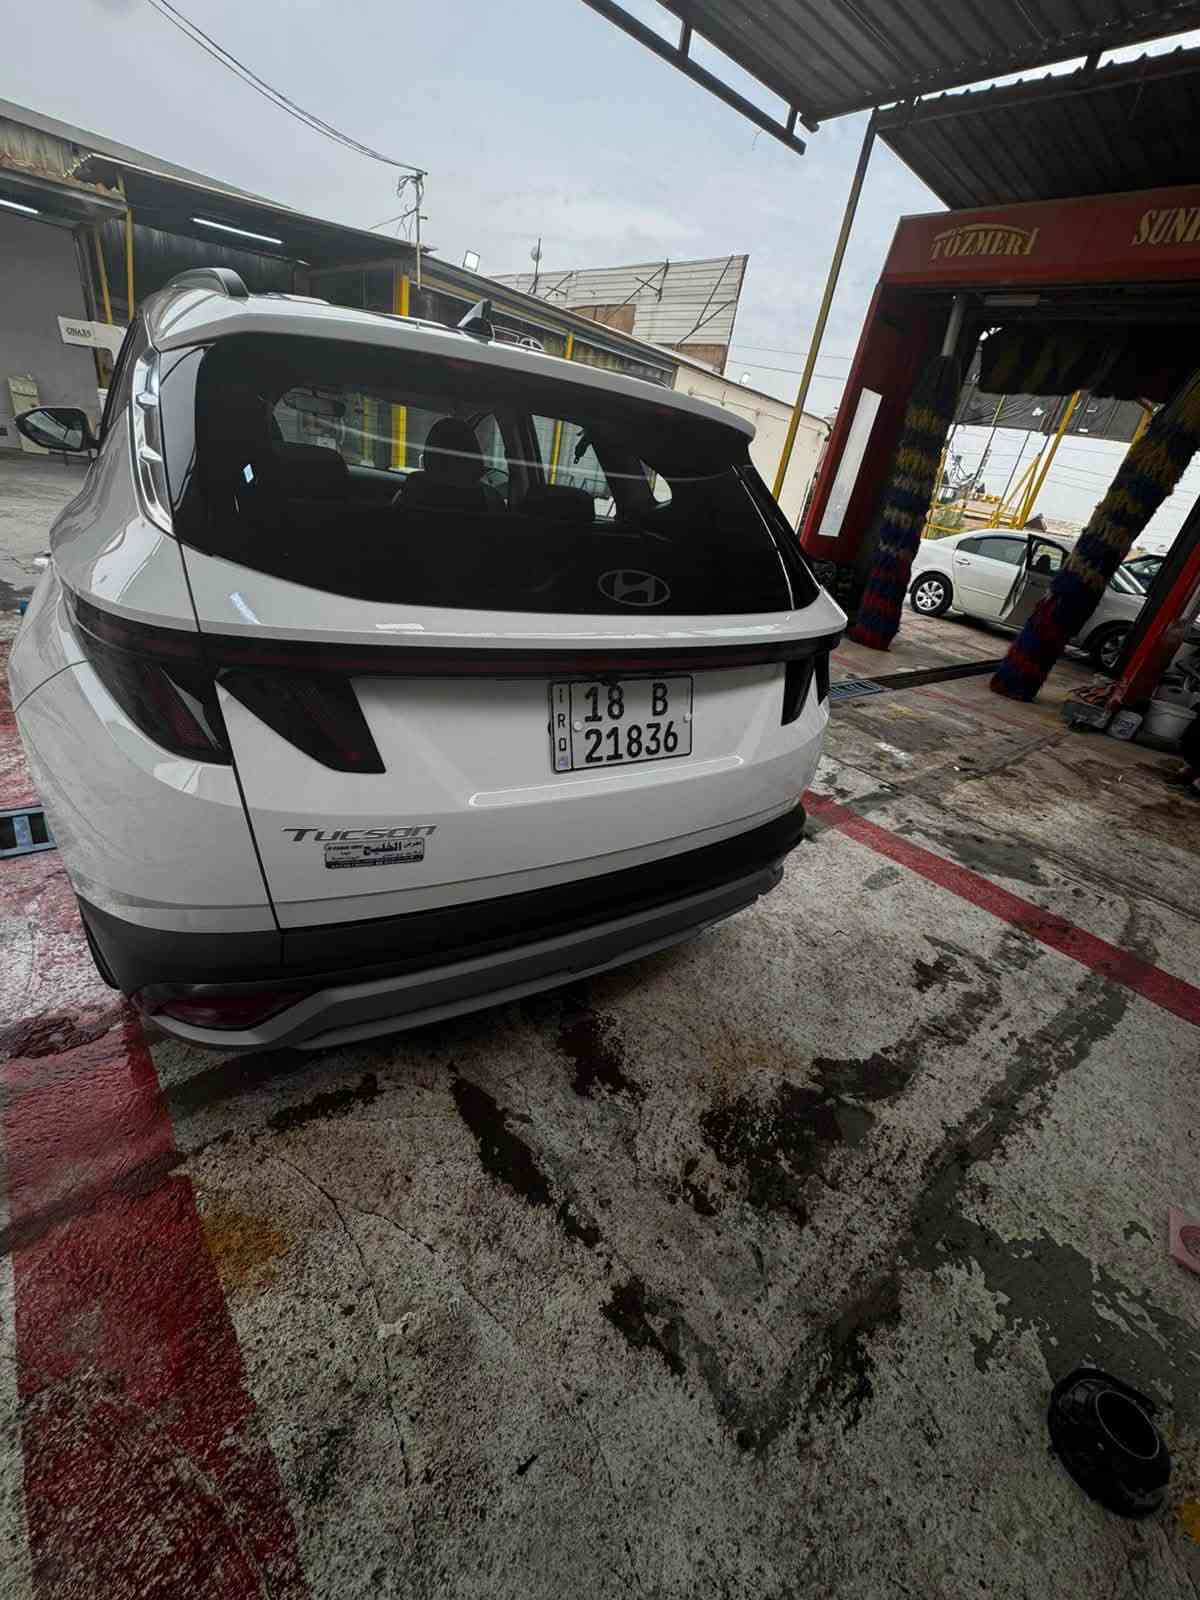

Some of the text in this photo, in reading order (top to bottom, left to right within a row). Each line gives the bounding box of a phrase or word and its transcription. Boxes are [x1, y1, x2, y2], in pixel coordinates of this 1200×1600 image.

[584, 682, 669, 723] 18 B
[584, 720, 679, 763] 21836
